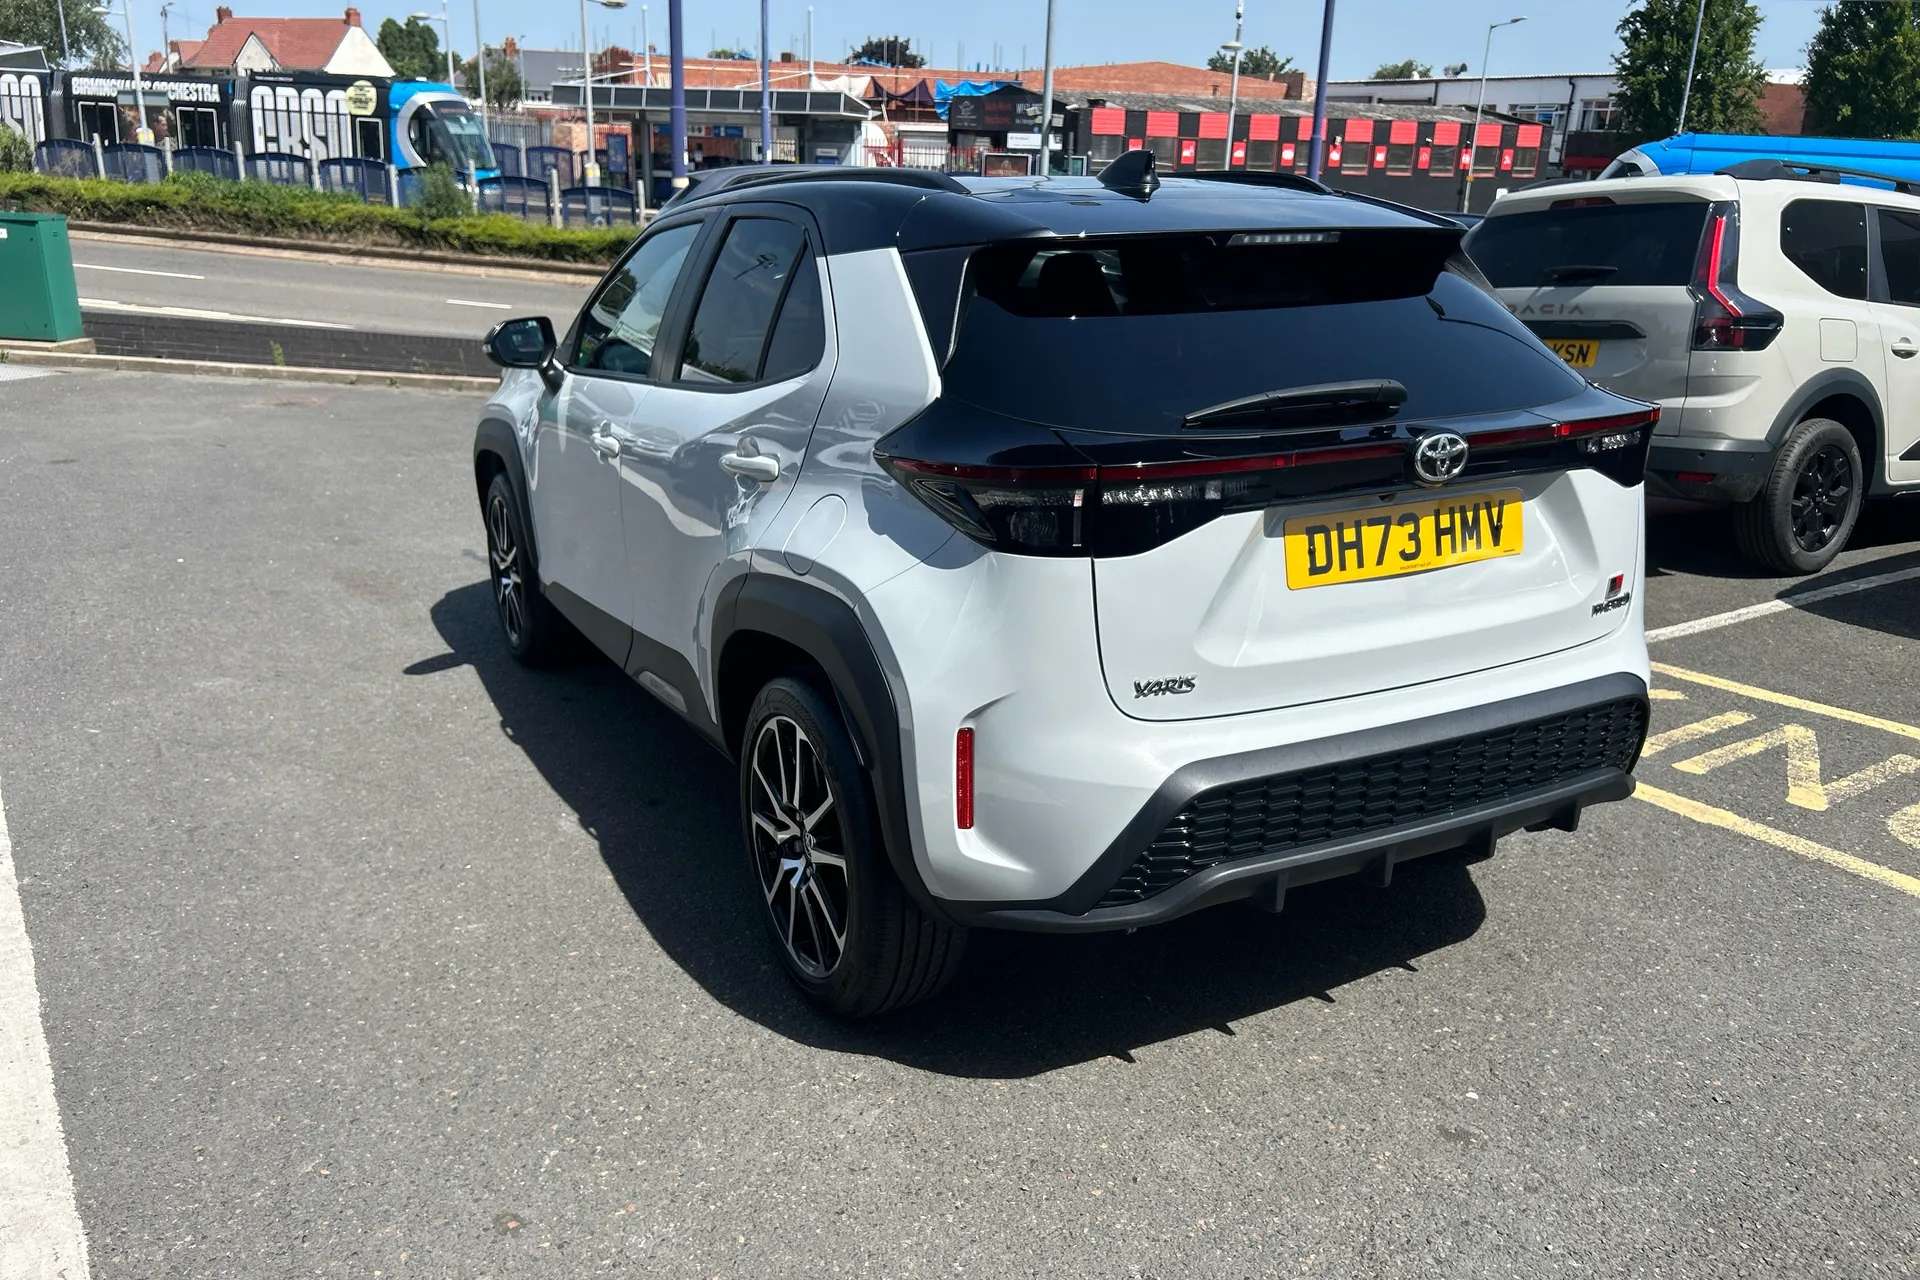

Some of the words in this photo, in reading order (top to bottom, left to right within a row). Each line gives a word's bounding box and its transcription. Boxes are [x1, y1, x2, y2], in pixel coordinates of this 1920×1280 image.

[72, 77, 151, 97] BIRMINGHA'S
[153, 82, 220, 102] ORCHESTRA
[1506, 303, 1584, 315] DACIA
[1306, 512, 1422, 576] DH73
[1434, 500, 1505, 556] HMV
[1134, 675, 1197, 699] YARIS
